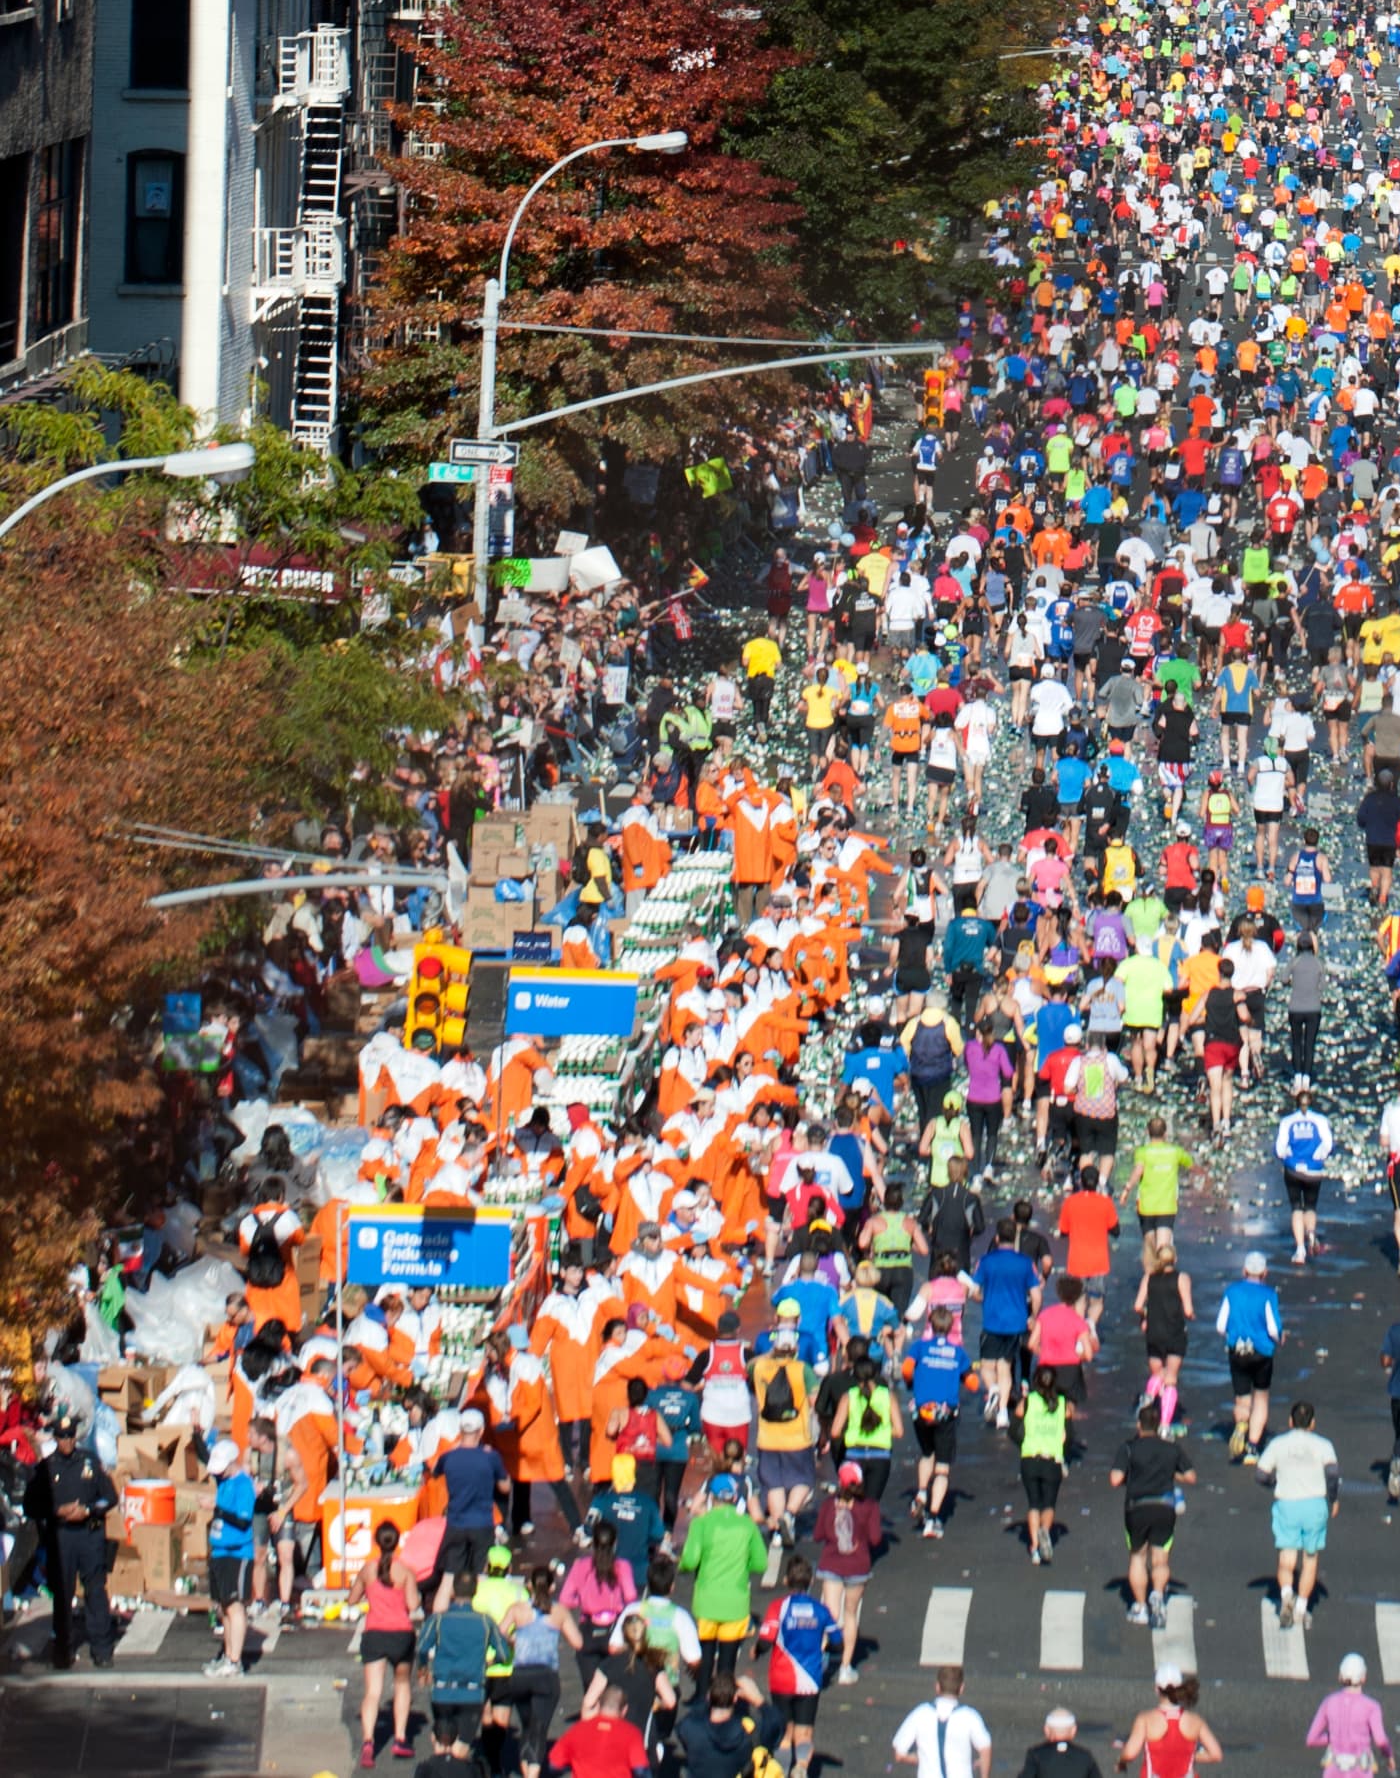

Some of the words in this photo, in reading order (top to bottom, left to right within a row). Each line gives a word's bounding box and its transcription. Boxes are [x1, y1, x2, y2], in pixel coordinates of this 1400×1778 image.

[461, 448, 478, 456] ONE
[489, 450, 507, 458] WAY
[535, 994, 570, 1009] Water
[381, 1260, 442, 1277] Formula
